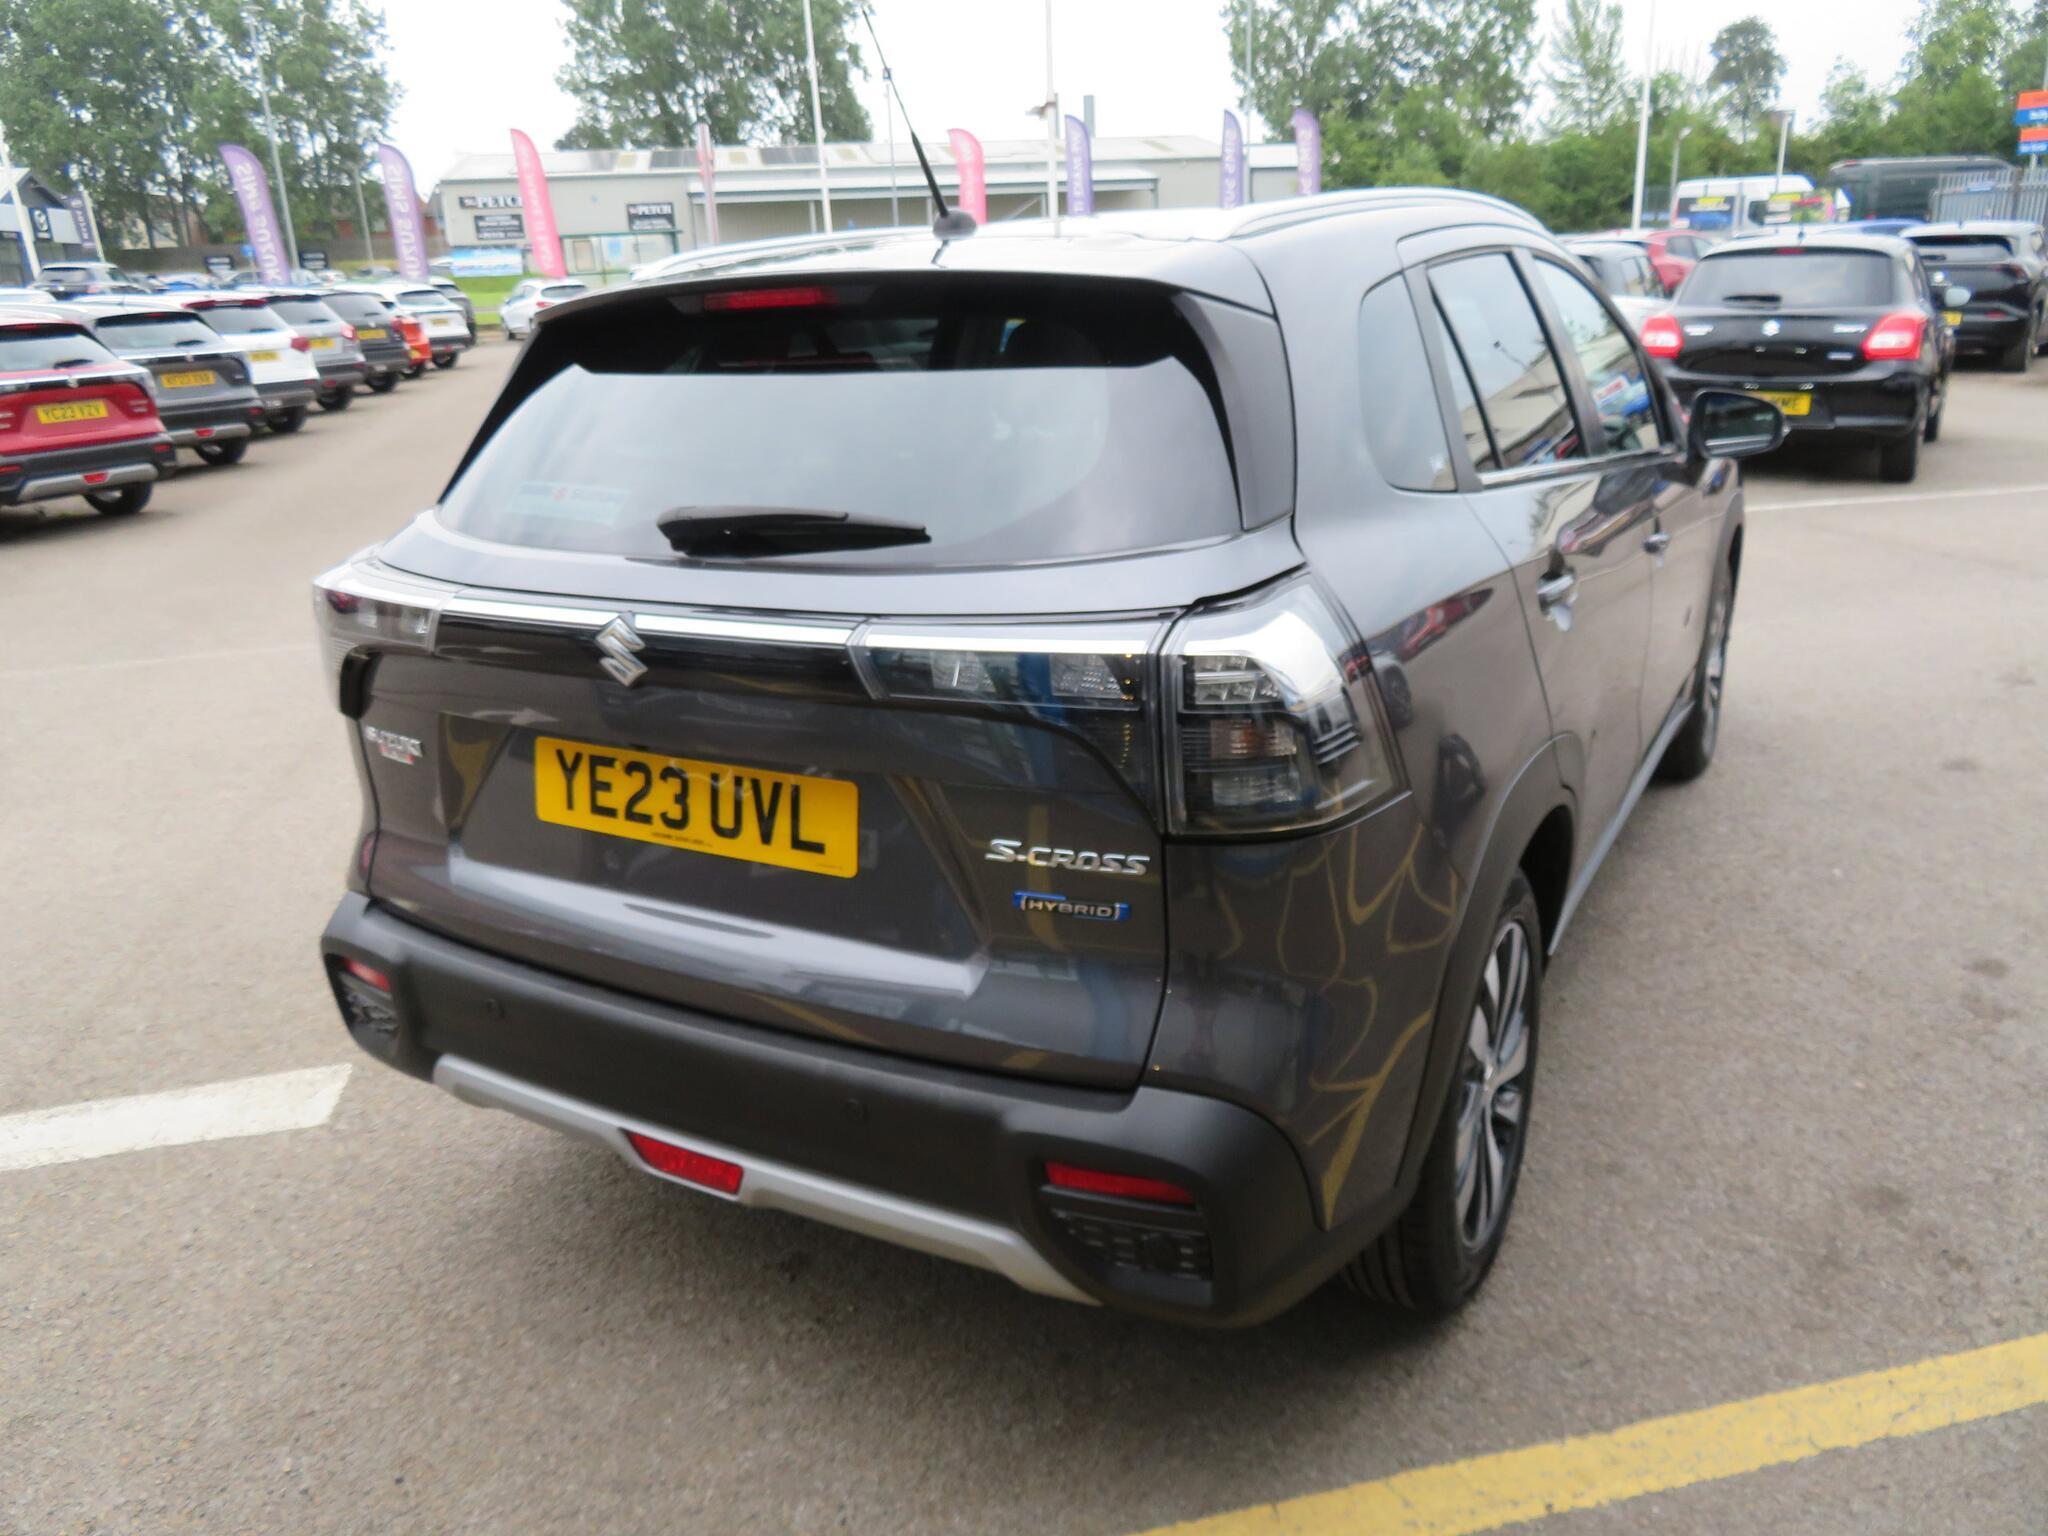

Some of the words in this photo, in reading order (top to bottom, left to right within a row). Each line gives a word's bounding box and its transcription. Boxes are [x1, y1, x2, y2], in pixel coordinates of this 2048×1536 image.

[554, 747, 691, 833] YE23
[709, 772, 827, 855] UVL
[984, 838, 1151, 876] S-CROSS
[1026, 898, 1114, 919] HYBRID
